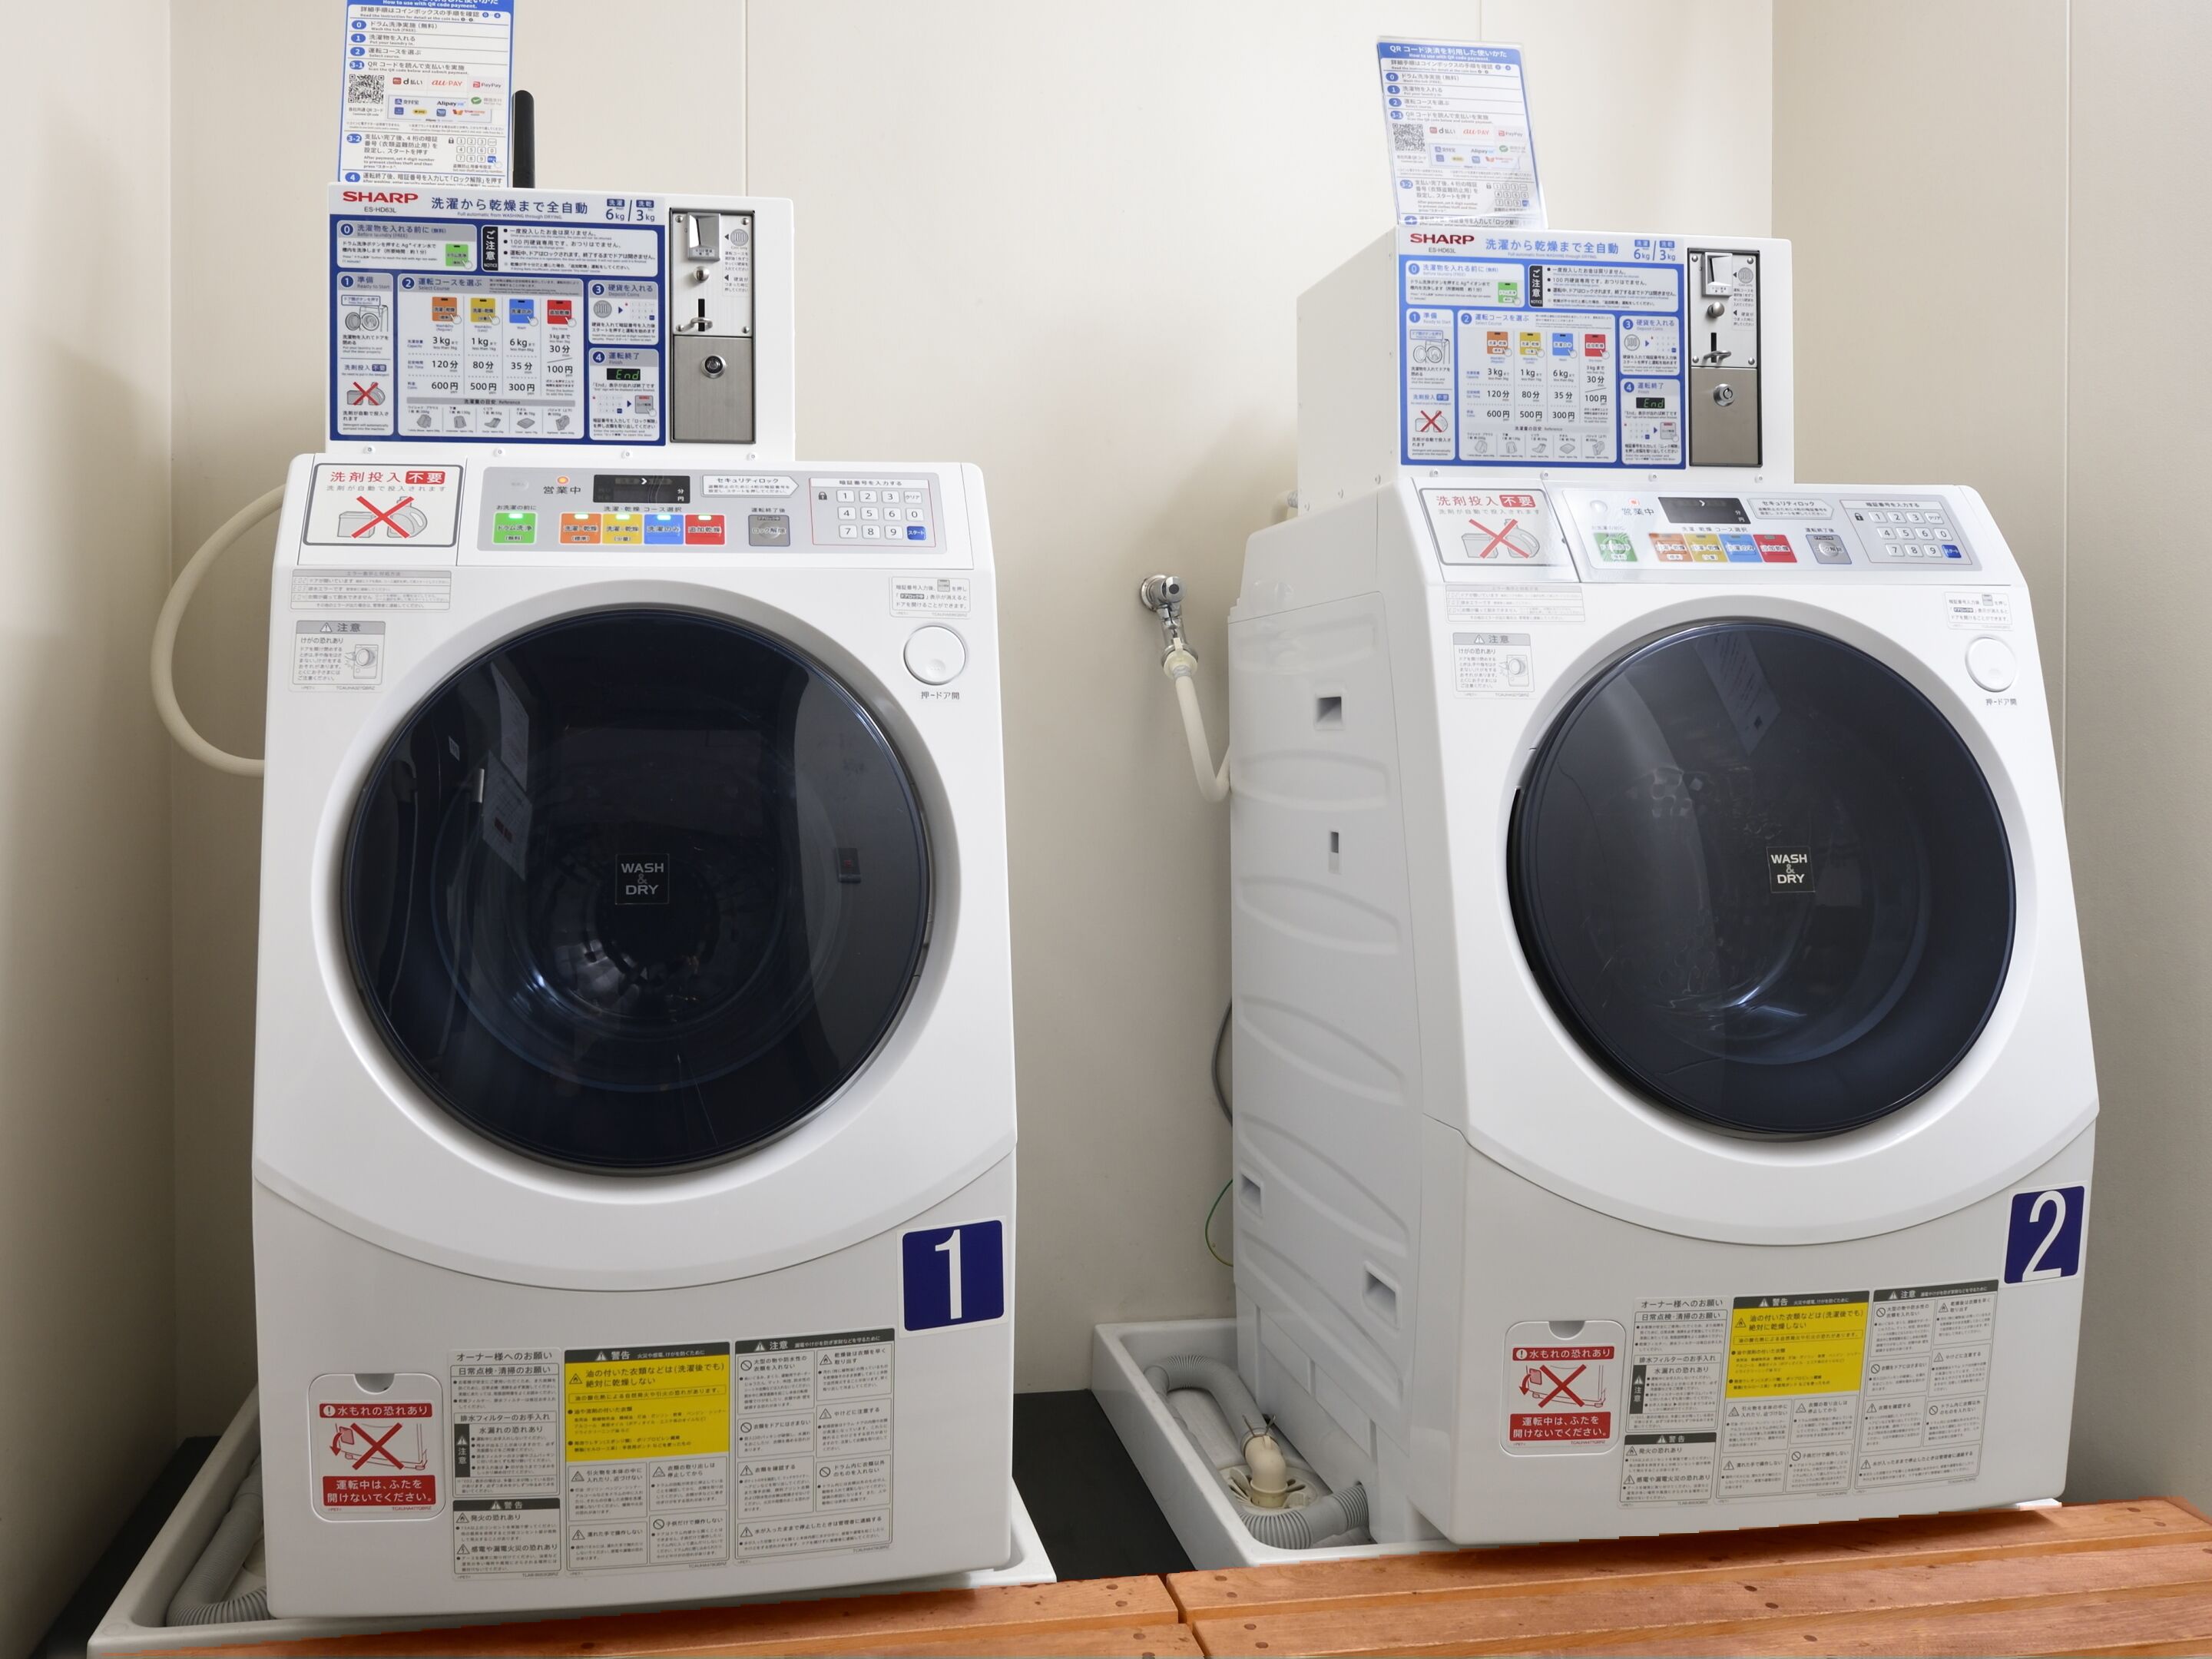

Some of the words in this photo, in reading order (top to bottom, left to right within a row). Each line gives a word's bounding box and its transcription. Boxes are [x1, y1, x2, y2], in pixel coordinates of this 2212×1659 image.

[343, 191, 419, 204] SHARP
[431, 197, 588, 215] 洗濯から乾燥まで全自動
[357, 225, 429, 233] 洗濯物を入れる前に
[1410, 233, 1475, 244] SHARP
[485, 230, 495, 260] ご注意
[1485, 238, 1619, 254] 洗濯から乾燥まで全自動
[419, 278, 482, 286] 運転コースを選ぶ
[1532, 270, 1541, 298] ご注意
[616, 369, 639, 379] End
[1644, 399, 1664, 408] End
[330, 472, 401, 482] 洗剤投入
[409, 472, 442, 483] 不要
[544, 485, 581, 495] 営業中
[1437, 496, 1499, 506] 洗剤投入
[1502, 497, 1533, 506] 不要
[337, 623, 360, 632] 注意
[1488, 635, 1509, 644] 注意
[1770, 854, 1807, 863] WASH
[621, 863, 664, 873] WASH
[1786, 864, 1795, 873] &
[637, 873, 647, 884] &
[1777, 874, 1805, 883] DRY
[626, 885, 659, 895] DRY
[2022, 1190, 2066, 1282] 2
[935, 1229, 962, 1320] 1
[1641, 1300, 1723, 1309] オーナー様へのお願い
[1749, 1323, 1806, 1331] 絶対に乾燥しない
[456, 1352, 552, 1362] オーナー様へのお願い
[1530, 1349, 1611, 1358] 水もれの恐れあり
[586, 1378, 655, 1388] 絶対に乾燥しない
[338, 1406, 428, 1416] 水もれの恐れあり
[461, 1413, 550, 1422] 排水フィルターのお手入れ
[1522, 1416, 1599, 1426] 運転中は、ふたを
[1514, 1429, 1607, 1438] 開けないでください。
[336, 1479, 422, 1490] 運転中は、ふたを
[327, 1493, 432, 1503] 開けないでください。
